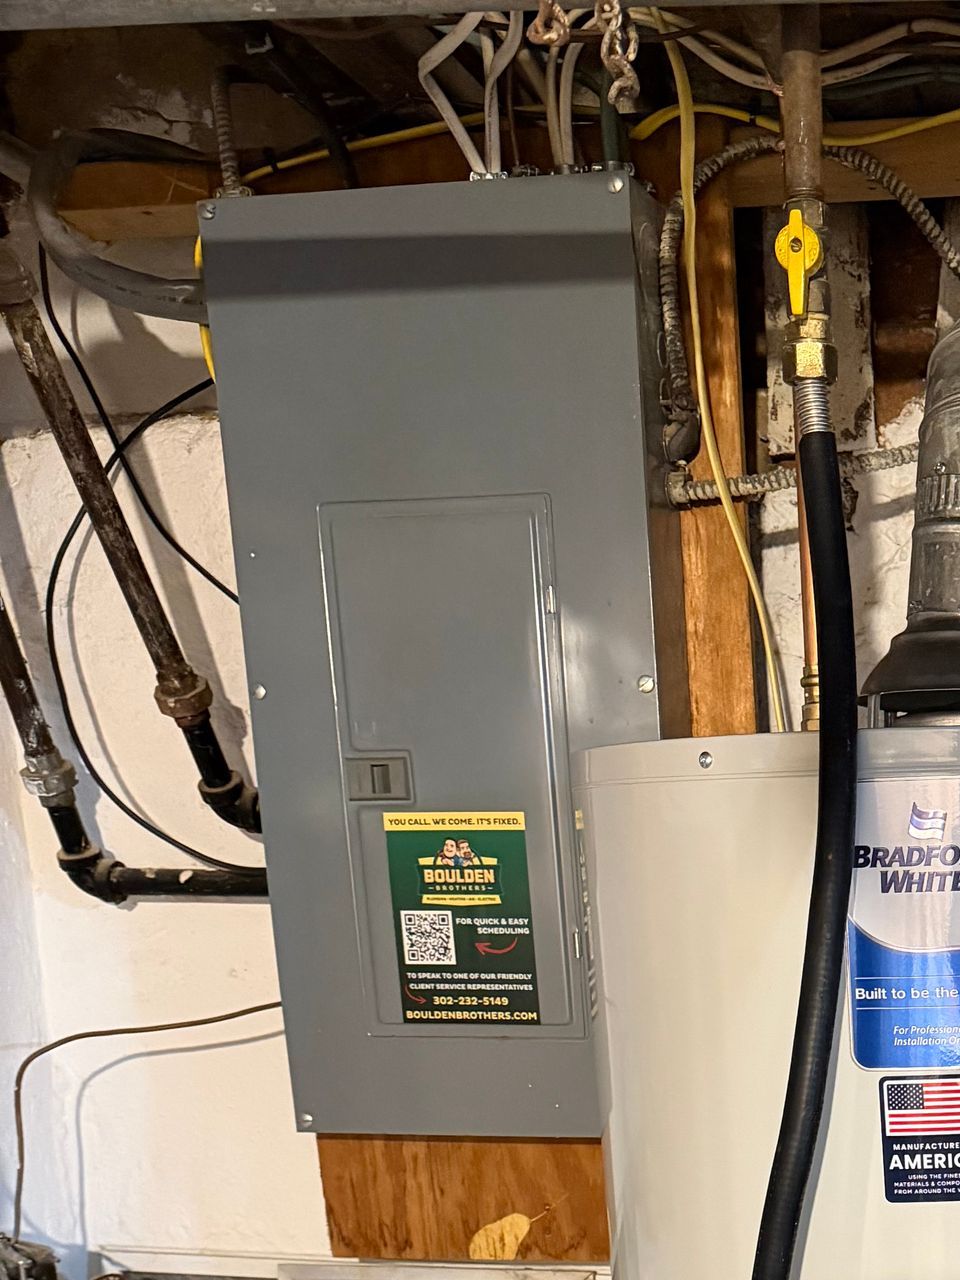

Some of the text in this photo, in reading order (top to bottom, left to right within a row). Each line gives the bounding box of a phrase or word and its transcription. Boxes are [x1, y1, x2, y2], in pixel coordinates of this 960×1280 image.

[423, 869, 495, 883] BOULDEN
[474, 918, 499, 926] QUICK
[855, 988, 887, 1000] Built
[891, 988, 906, 999] to
[911, 988, 929, 998] be
[935, 987, 959, 998] the
[433, 996, 508, 1006] 302-232-5149
[406, 1011, 537, 1020] BOULDENBROTHERS.COM
[893, 1025, 908, 1034] For
[894, 1036, 946, 1046] Installation
